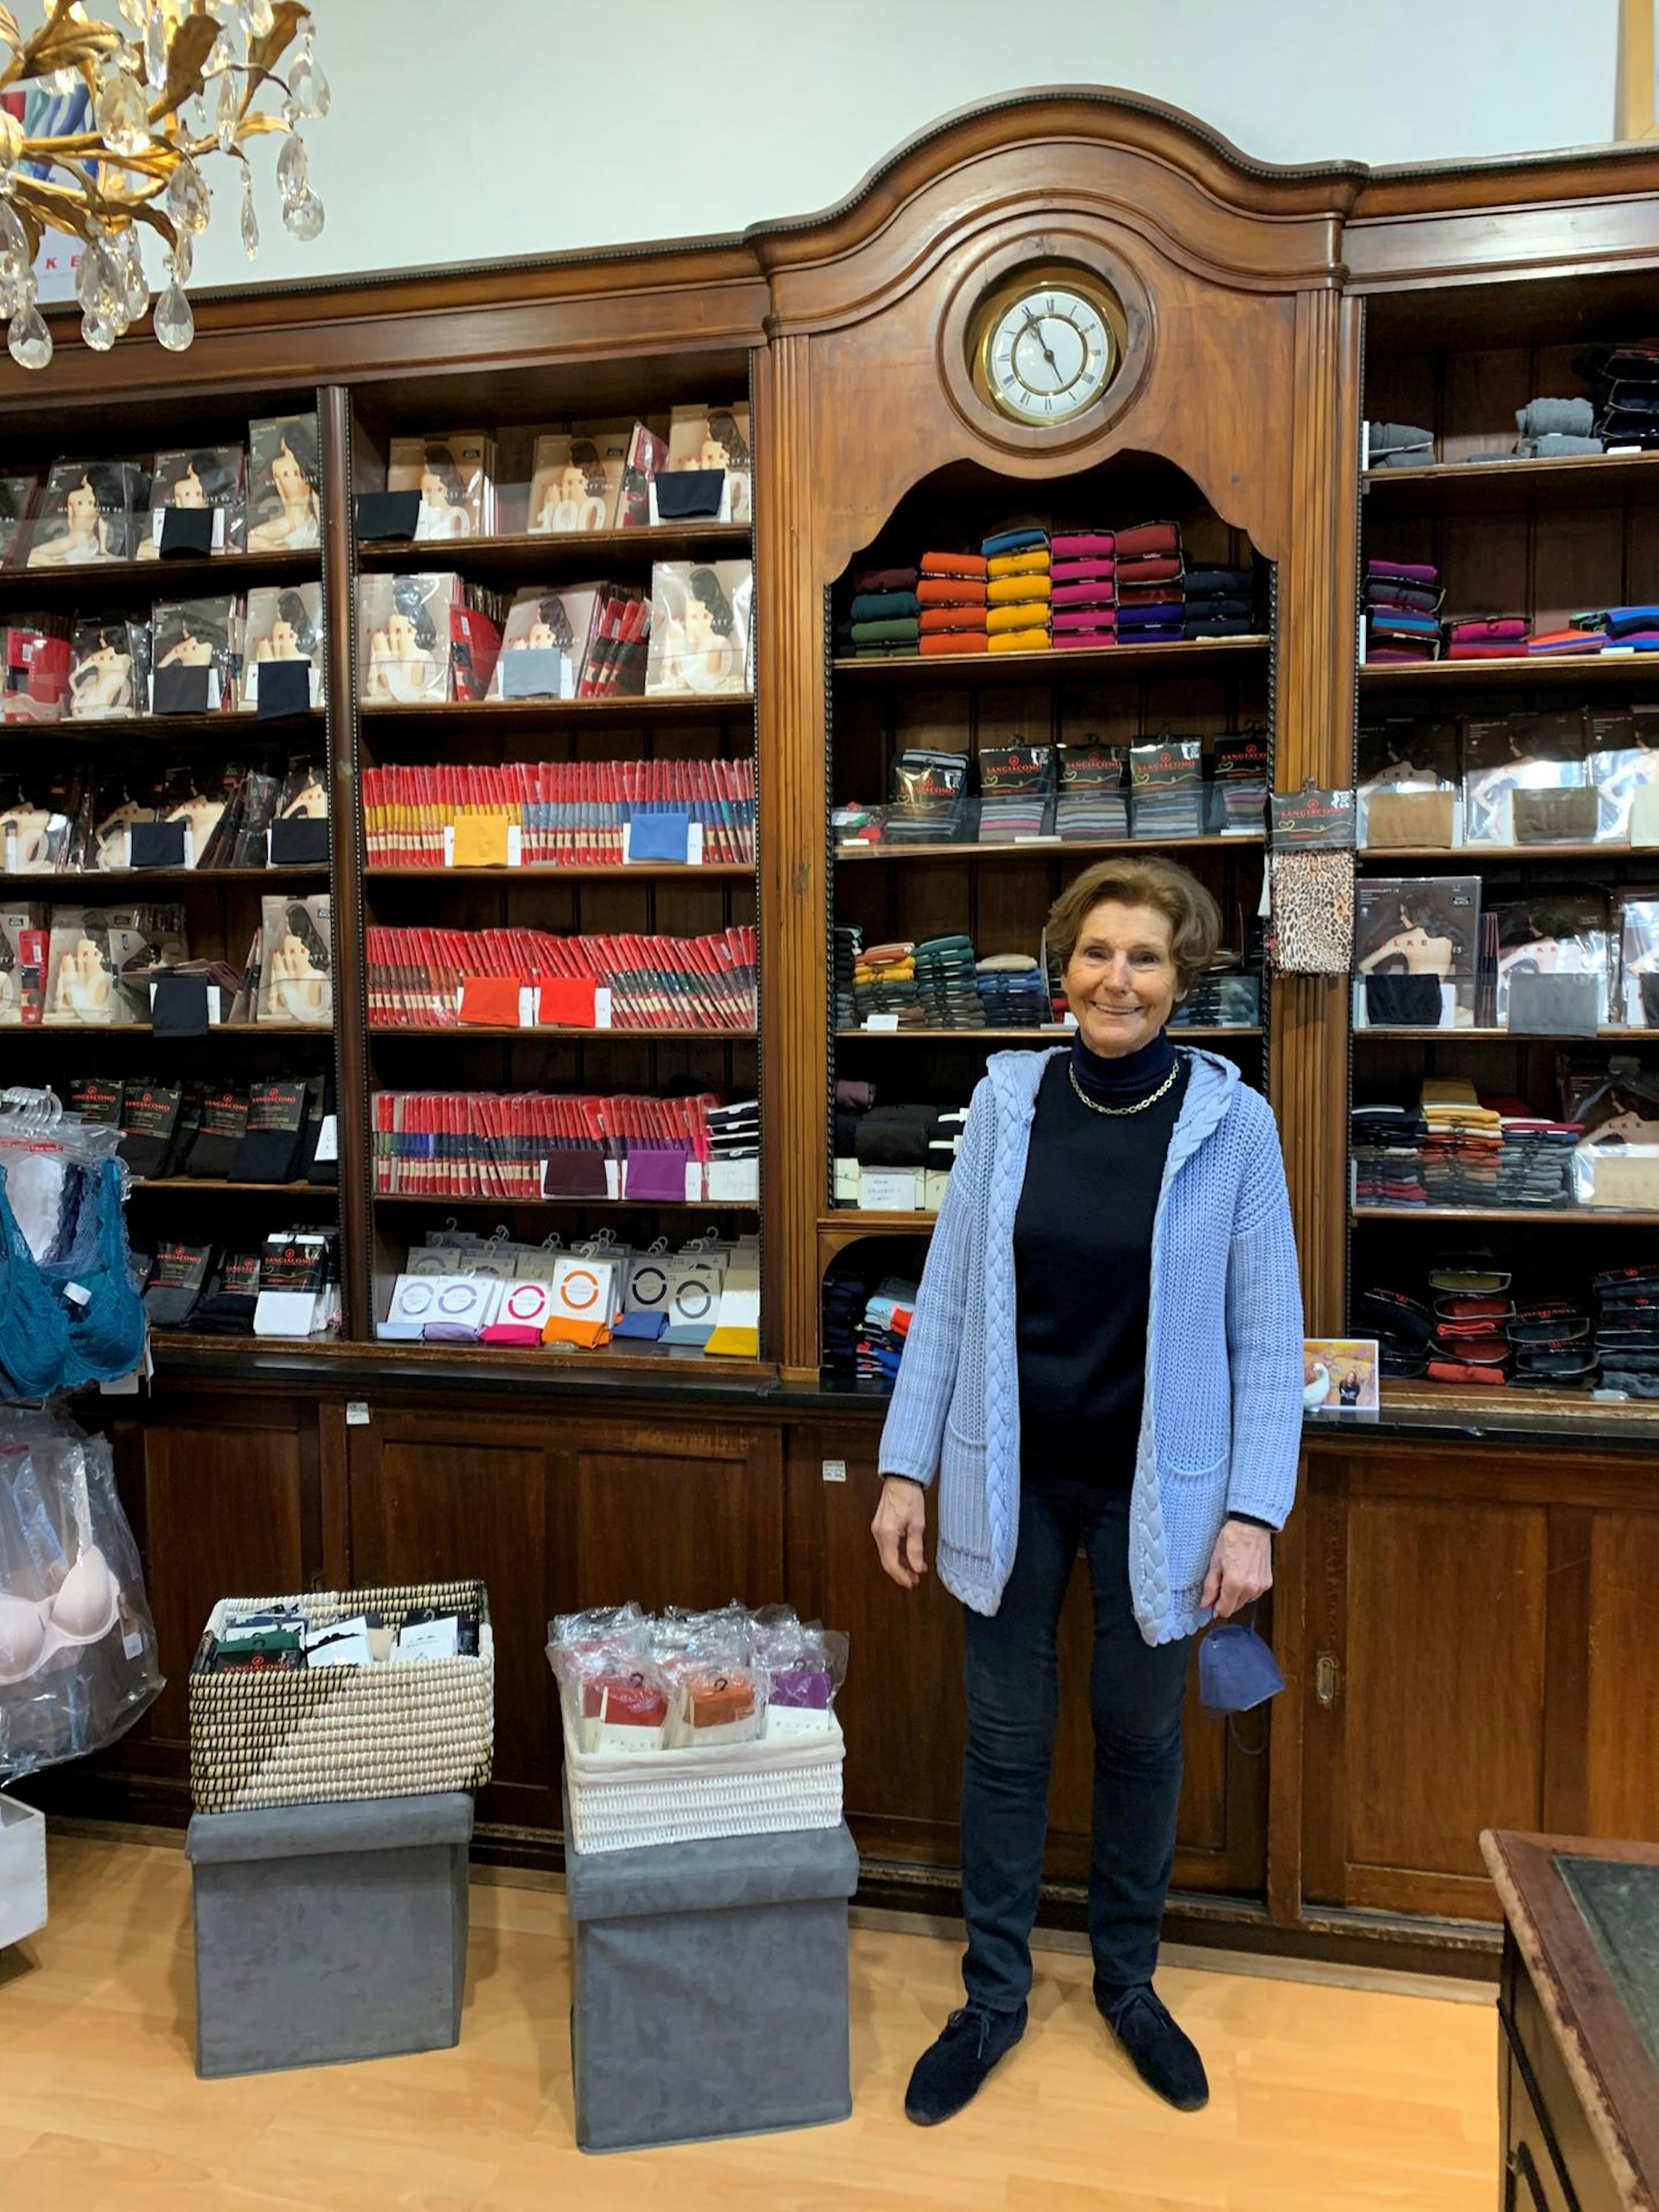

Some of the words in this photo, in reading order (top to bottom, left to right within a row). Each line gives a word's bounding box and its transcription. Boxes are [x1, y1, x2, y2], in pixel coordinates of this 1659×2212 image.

[986, 763, 1042, 775] SANGIACOMO
[1066, 760, 1122, 770] SANGIACOMO
[1137, 759, 1195, 772] SANGIACOMO
[1281, 806, 1347, 818] SANGIACOMO
